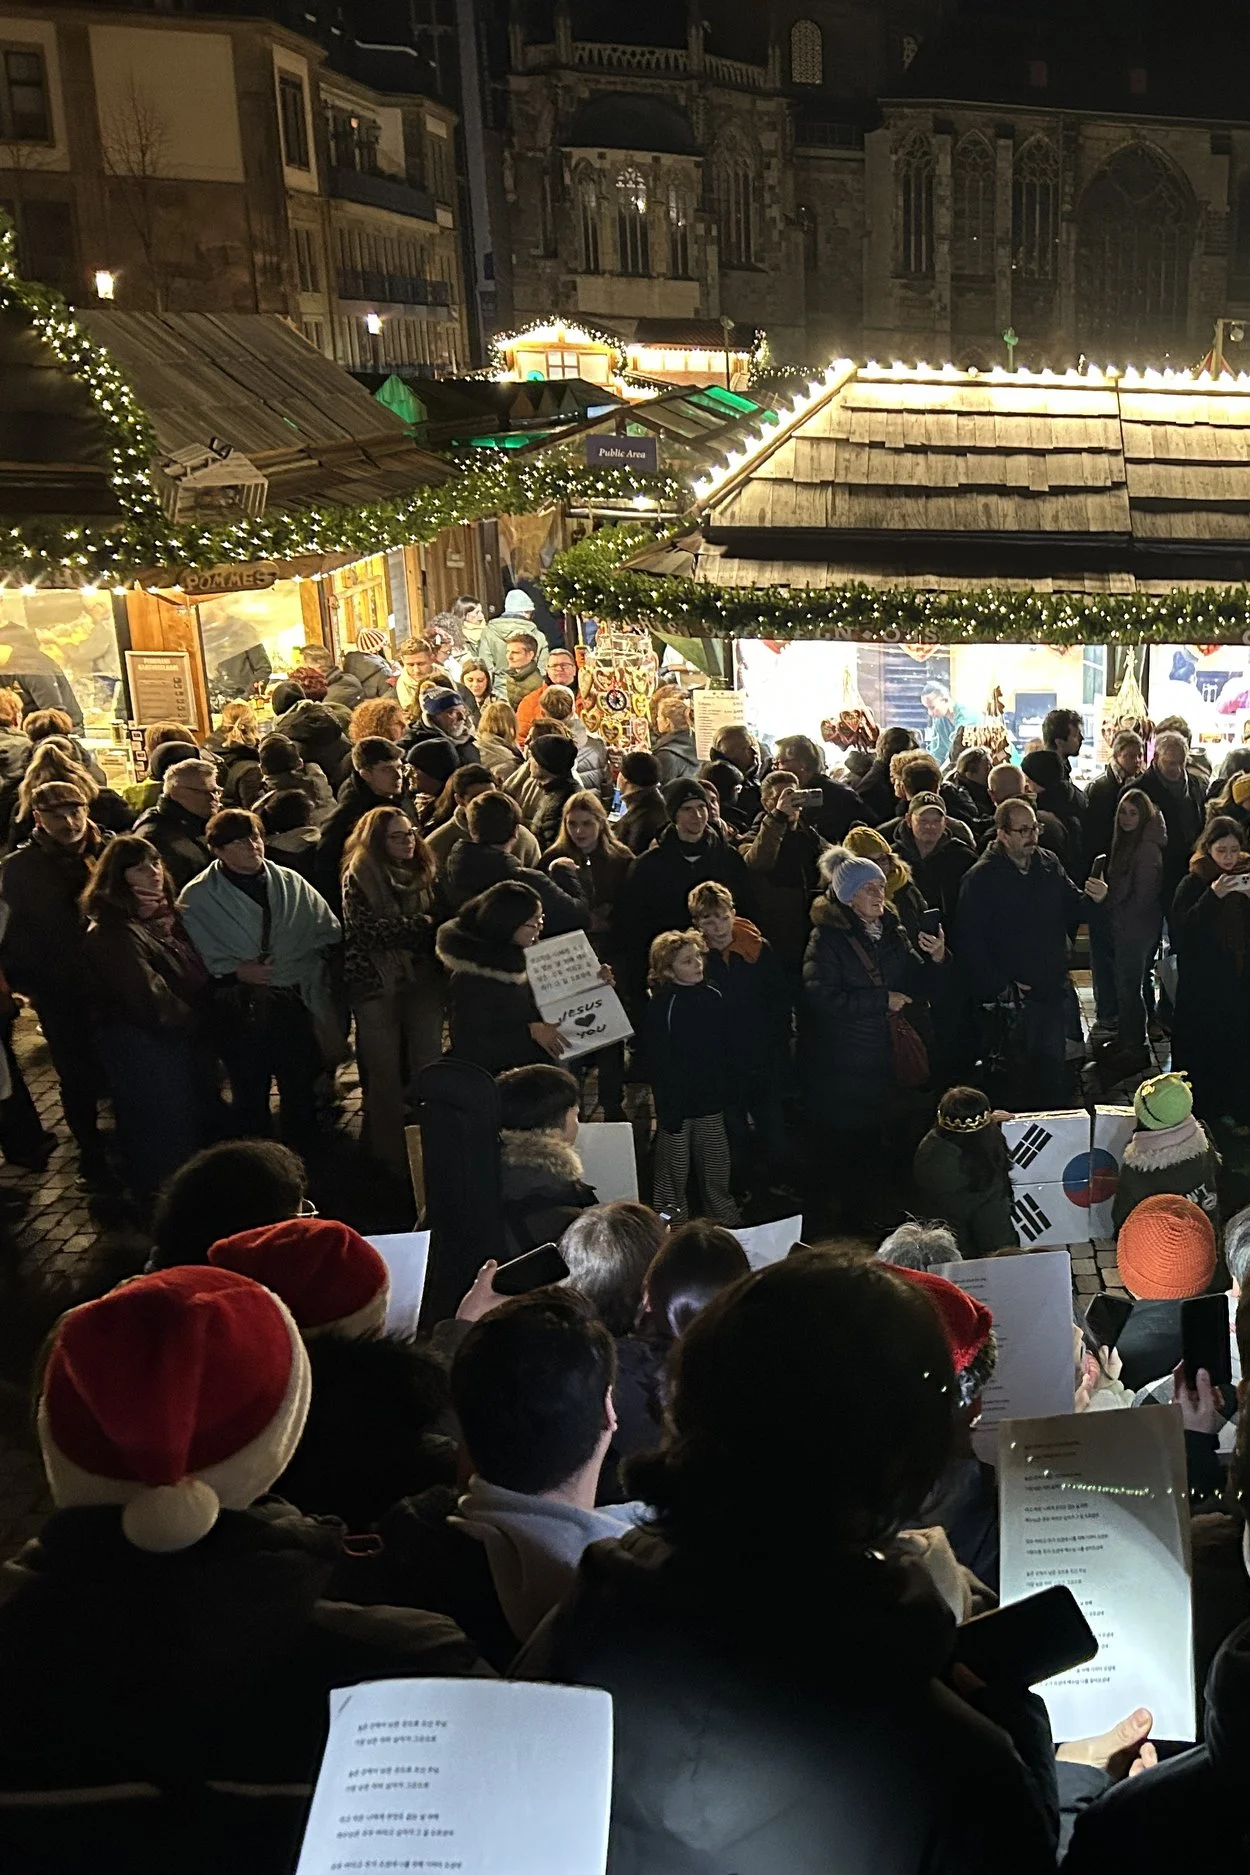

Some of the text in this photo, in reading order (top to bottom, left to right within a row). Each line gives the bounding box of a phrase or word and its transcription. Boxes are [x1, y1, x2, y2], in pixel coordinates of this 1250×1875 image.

[598, 448, 646, 459] Public Area
[186, 570, 267, 591] POMMES
[558, 1000, 602, 1023] JESUS
[576, 1024, 606, 1039] YOU
